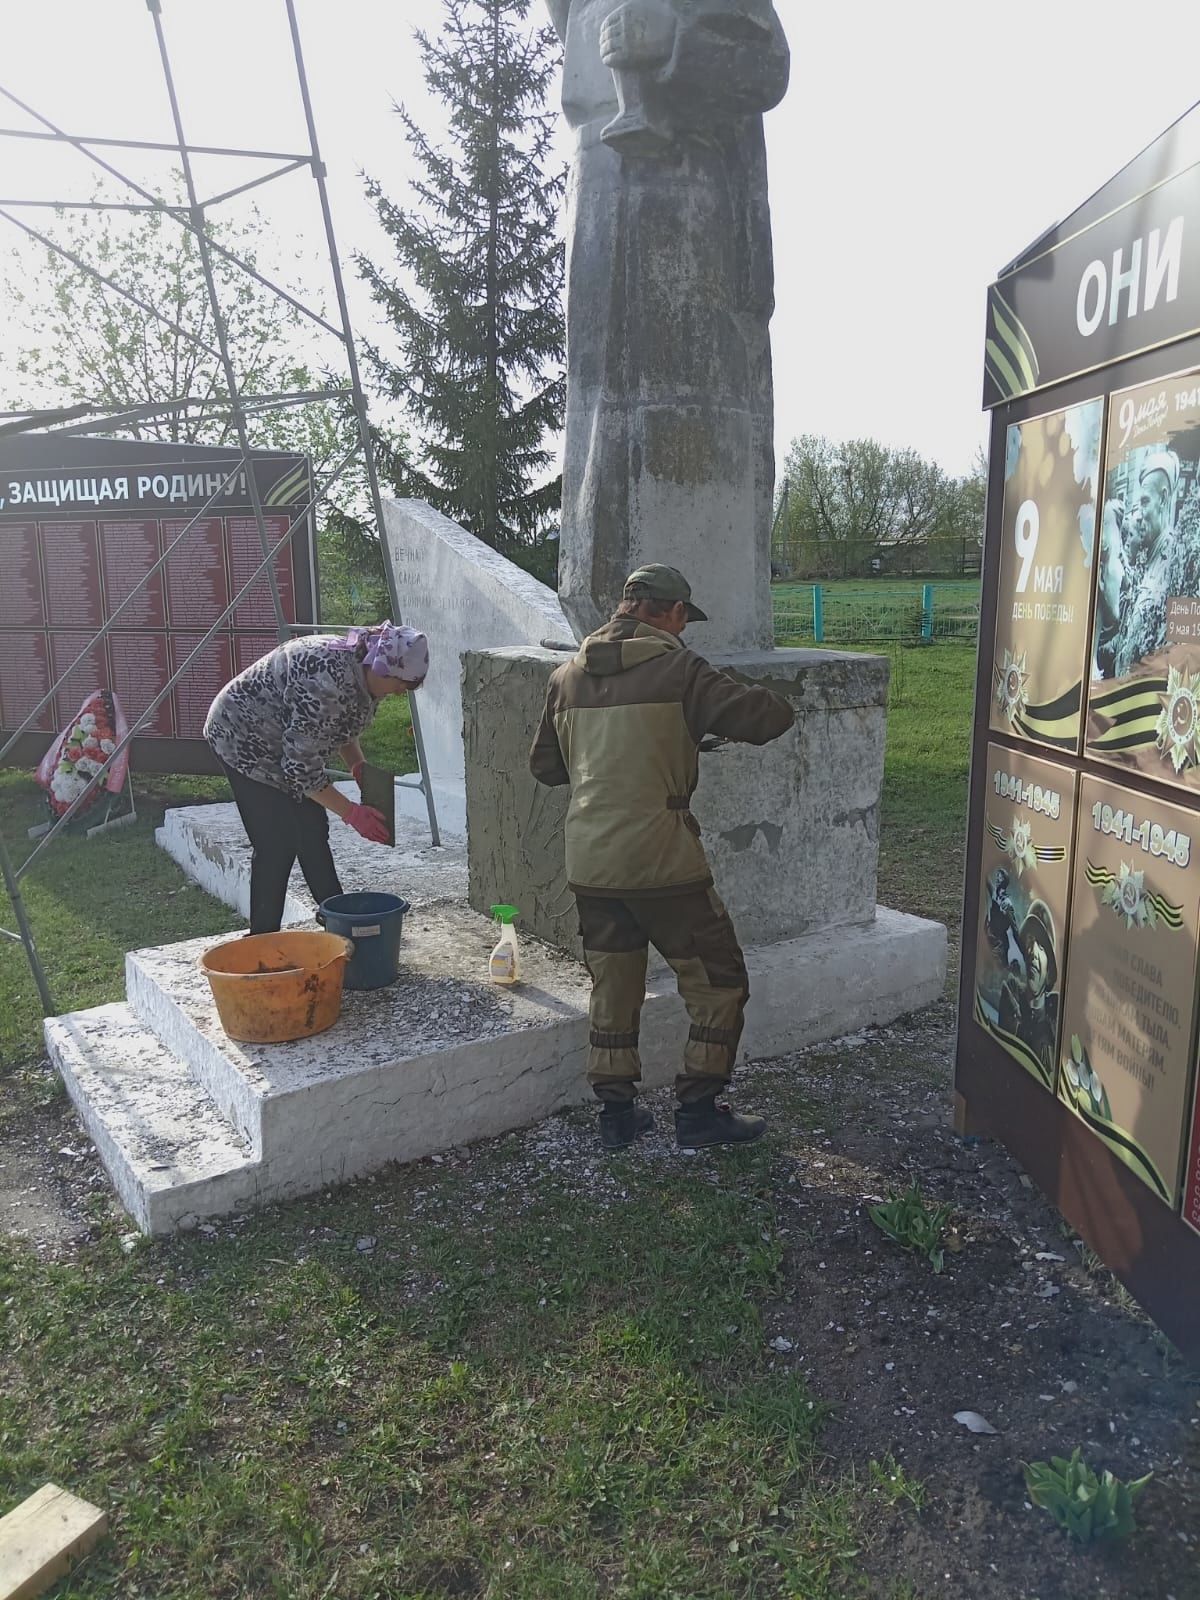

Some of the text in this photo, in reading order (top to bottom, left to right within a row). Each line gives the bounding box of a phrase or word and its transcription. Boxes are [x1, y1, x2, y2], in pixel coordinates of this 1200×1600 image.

[1076, 216, 1185, 337] ОНИ
[1118, 398, 1135, 449] 9
[8, 472, 247, 507] ЗАЩИЩАЯ РОДИНУ!
[1015, 499, 1064, 593] 9 МАЯ
[1012, 602, 1033, 621] ДЕНЬ
[1169, 621, 1175, 635] 9
[1176, 624, 1190, 636] мая
[1170, 601, 1189, 616] День
[993, 770, 1061, 820] 1941-1945
[1092, 801, 1191, 867] 1941-1945
